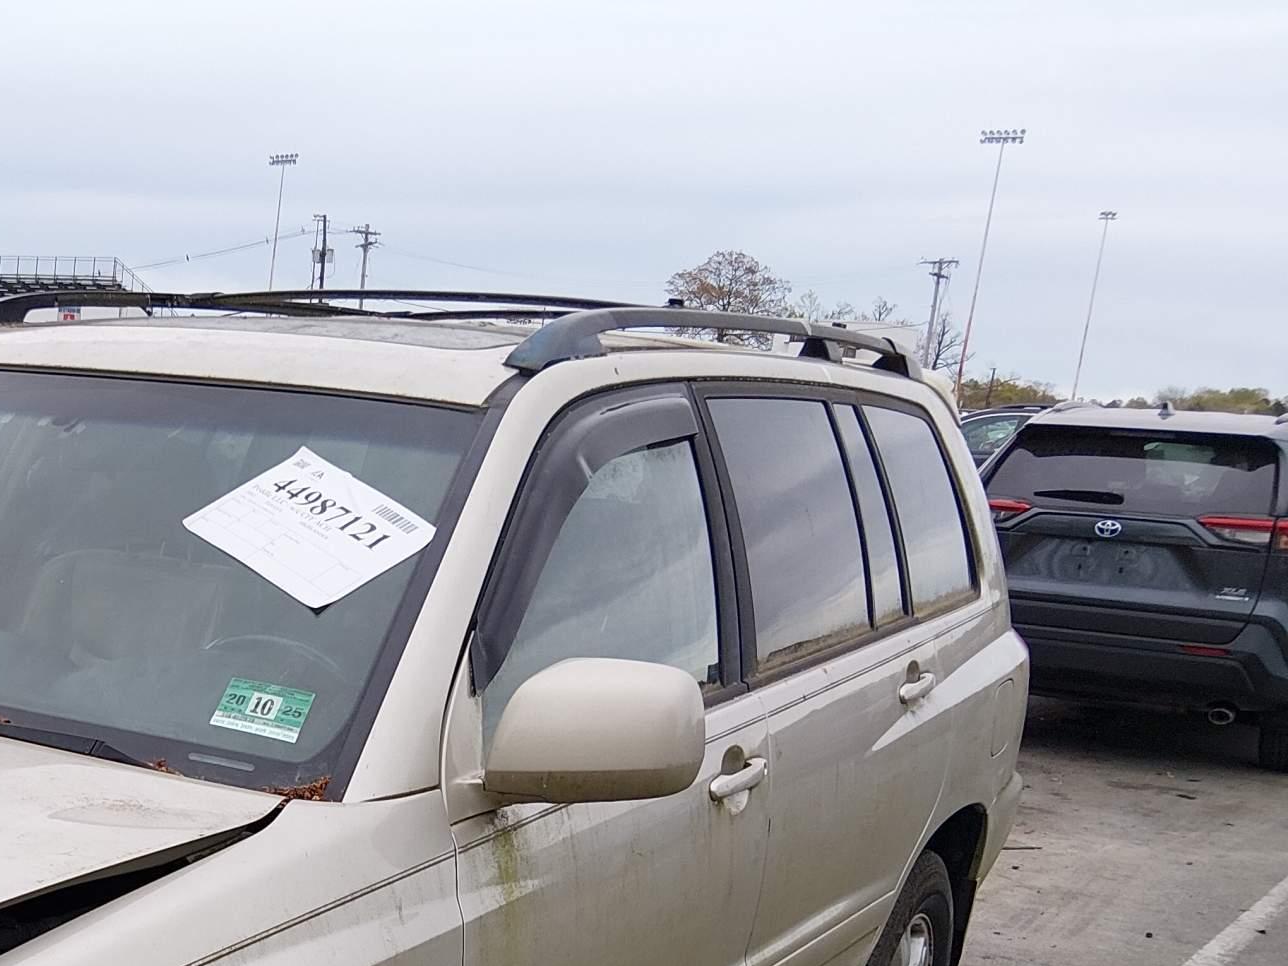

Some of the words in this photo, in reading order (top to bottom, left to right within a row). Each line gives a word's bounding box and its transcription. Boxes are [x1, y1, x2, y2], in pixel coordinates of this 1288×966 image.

[273, 479, 391, 550] 44987121
[226, 693, 246, 706] 20
[250, 696, 275, 716] 10
[281, 705, 304, 718] 25
